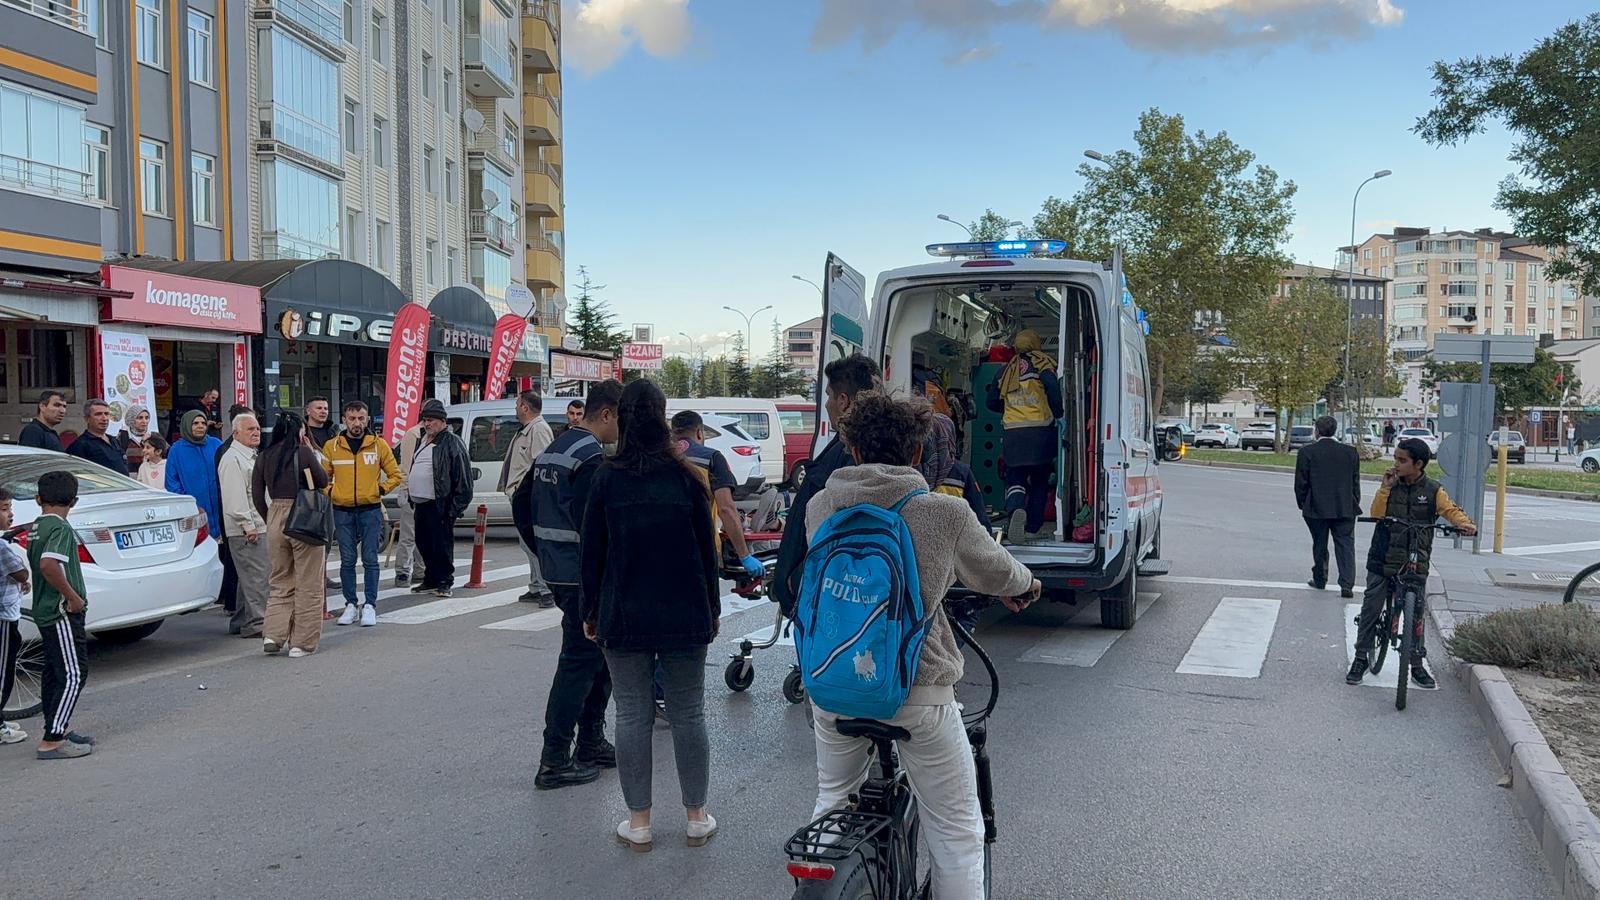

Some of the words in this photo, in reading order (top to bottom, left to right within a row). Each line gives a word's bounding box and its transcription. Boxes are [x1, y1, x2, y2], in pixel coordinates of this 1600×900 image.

[146, 280, 228, 316] komagene
[623, 345, 661, 358] ECZANE
[237, 355, 246, 407] koma
[122, 533, 134, 547] 01
[137, 530, 145, 545] V
[149, 527, 174, 543] 7545
[822, 577, 861, 603] POLO
